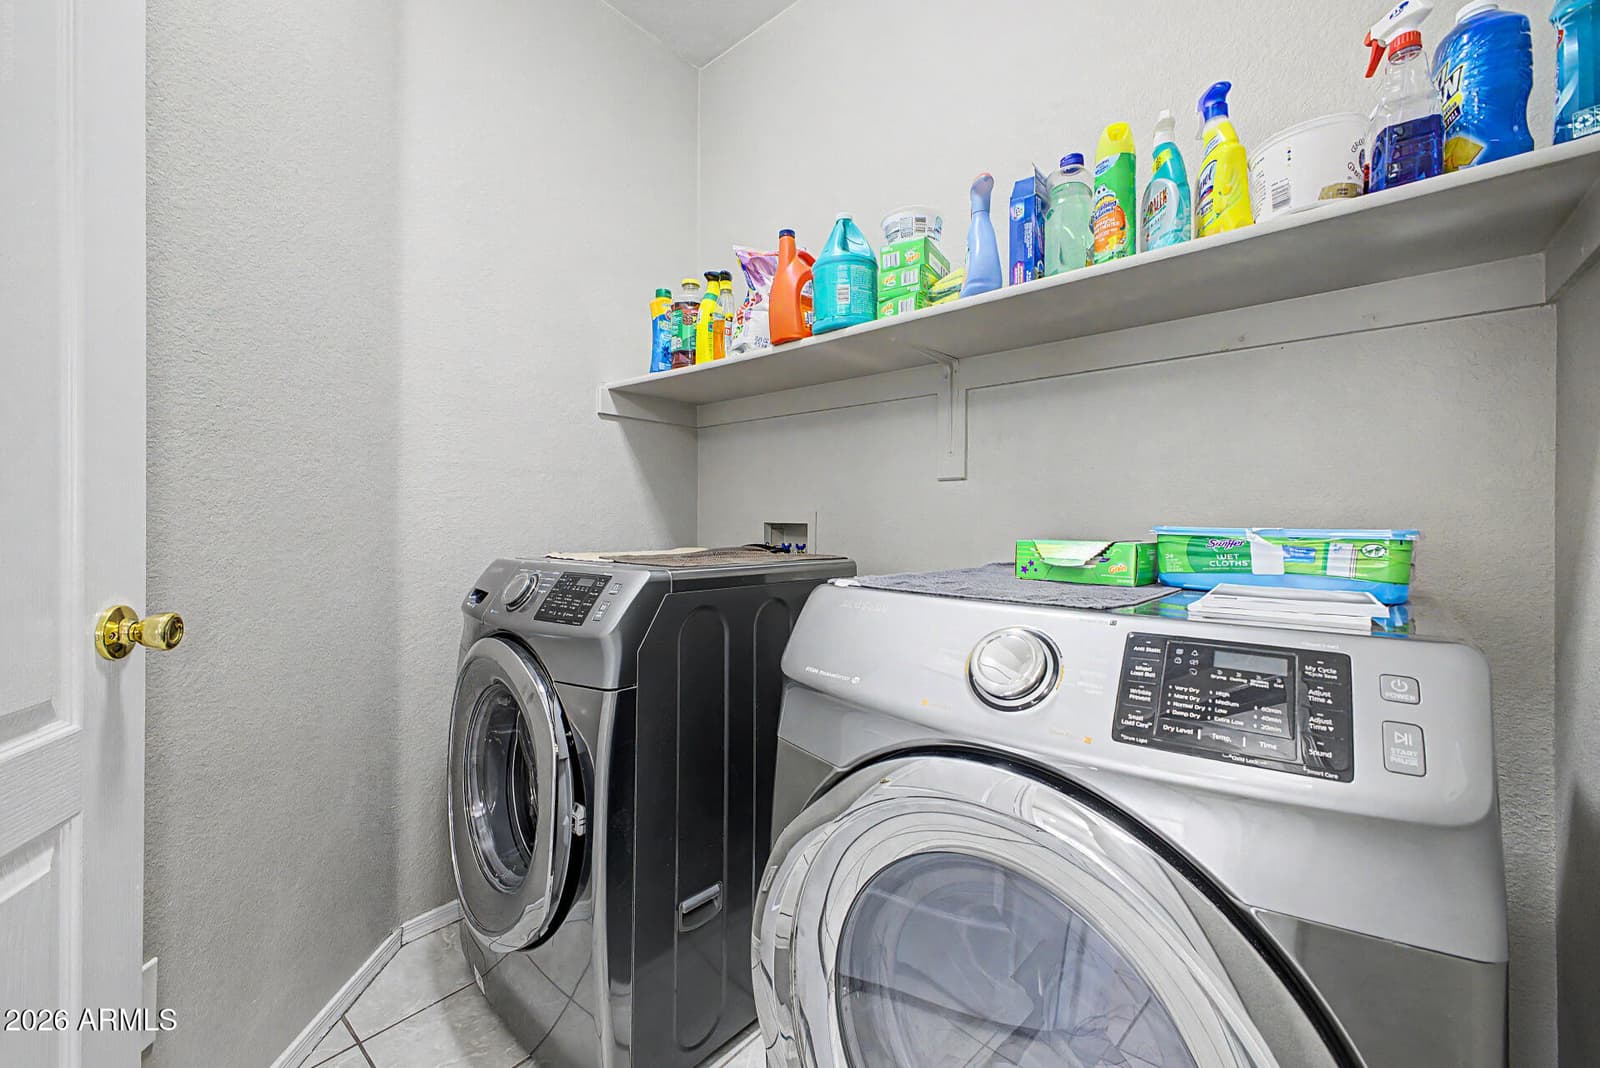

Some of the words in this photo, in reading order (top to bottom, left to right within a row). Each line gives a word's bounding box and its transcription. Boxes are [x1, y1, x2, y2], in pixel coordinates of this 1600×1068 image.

[1304, 665, 1316, 673] My
[1317, 666, 1337, 675] Cycle
[1188, 686, 1200, 694] Dry
[1308, 689, 1332, 698] Adjust
[1189, 694, 1201, 703] Dry
[1307, 695, 1326, 703] Time
[1384, 692, 1416, 701] POWER
[1194, 704, 1206, 712] Dry
[1189, 711, 1201, 720] Dry
[1309, 716, 1333, 726] Adjust
[1162, 724, 1175, 732] Dry
[1175, 726, 1194, 735] Level
[1308, 723, 1327, 731] Time
[1259, 740, 1278, 750] Time
[1390, 747, 1418, 757] START
